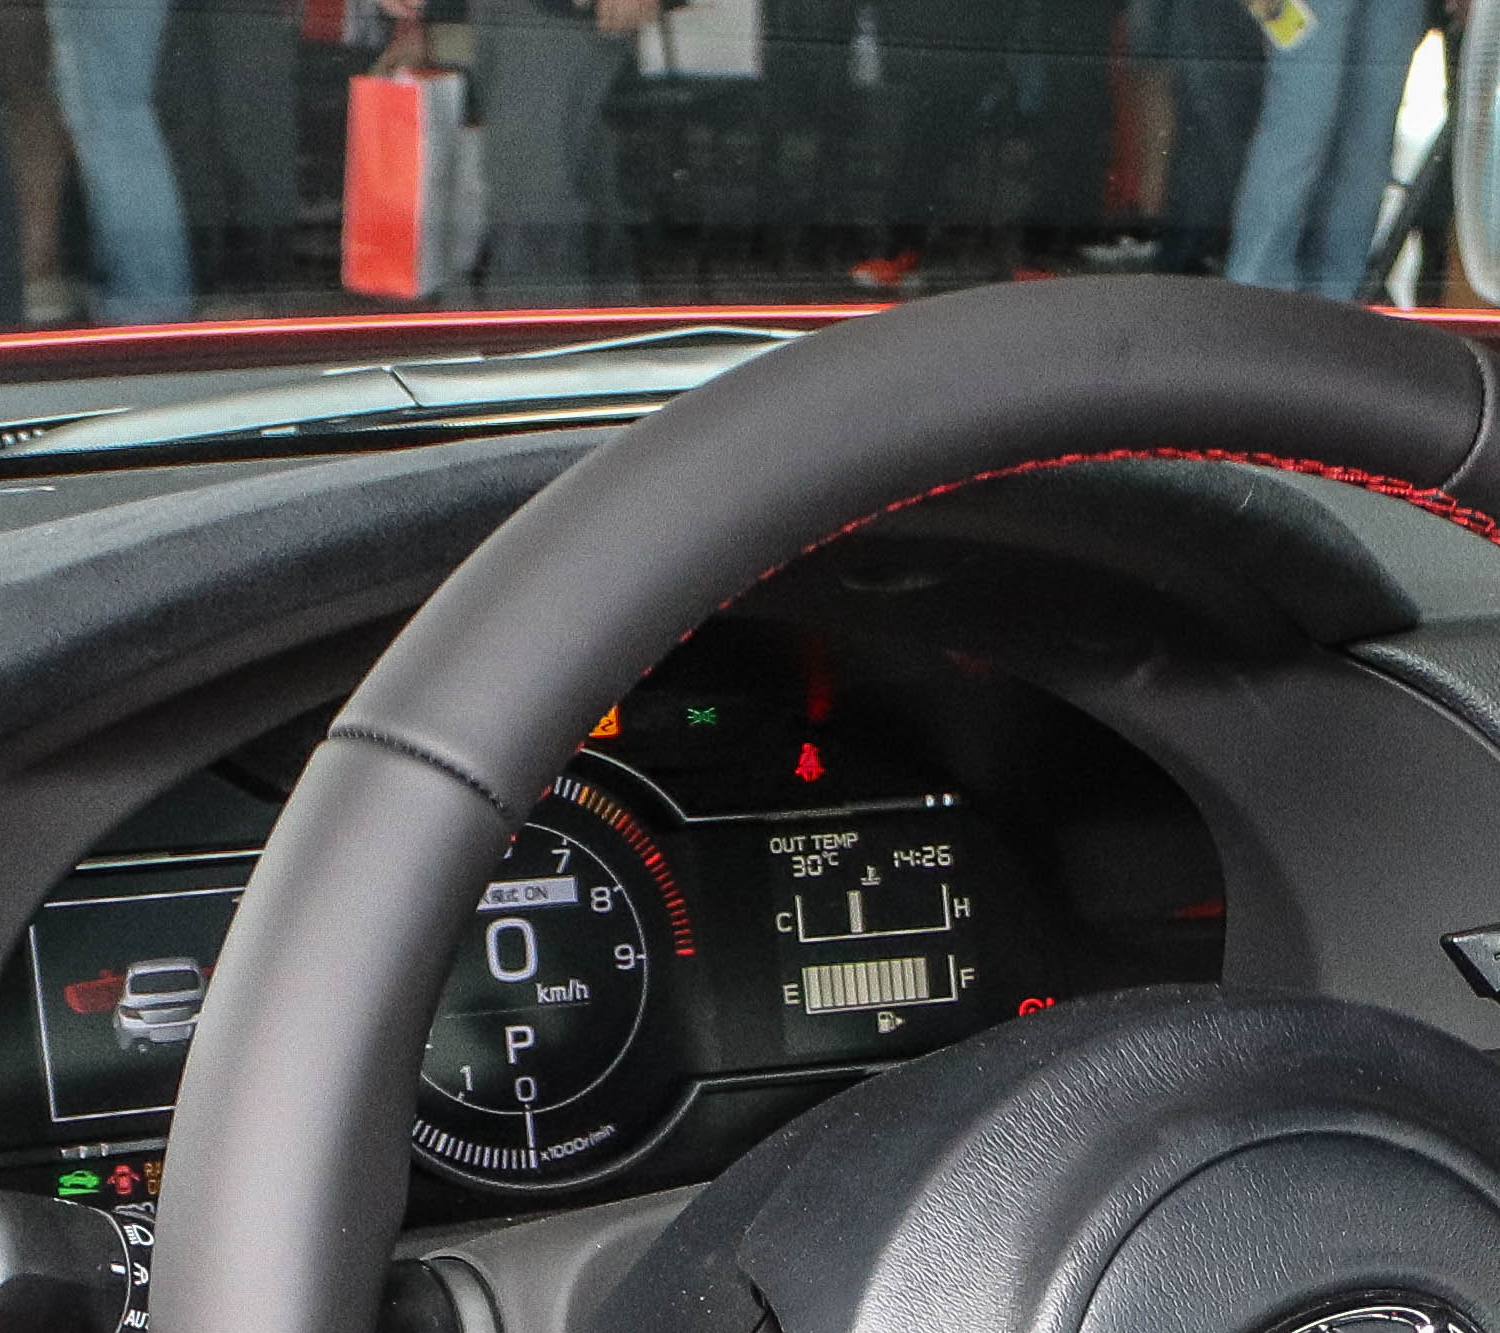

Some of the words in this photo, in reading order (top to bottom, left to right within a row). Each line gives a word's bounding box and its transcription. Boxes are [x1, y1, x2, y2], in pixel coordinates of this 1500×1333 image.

[769, 836, 806, 854] OUT
[810, 832, 859, 851] TEMP
[551, 848, 571, 874] 7
[892, 845, 952, 868] 14:26
[590, 886, 613, 914] 8
[953, 897, 971, 918] H
[775, 912, 793, 933] C
[485, 916, 538, 983] 0
[613, 943, 636, 970] 9
[535, 978, 590, 1004] km/h
[959, 967, 976, 989] F
[782, 983, 800, 1005] E
[504, 1025, 536, 1065] P
[459, 1064, 474, 1092] 1
[514, 1076, 537, 1102] 0
